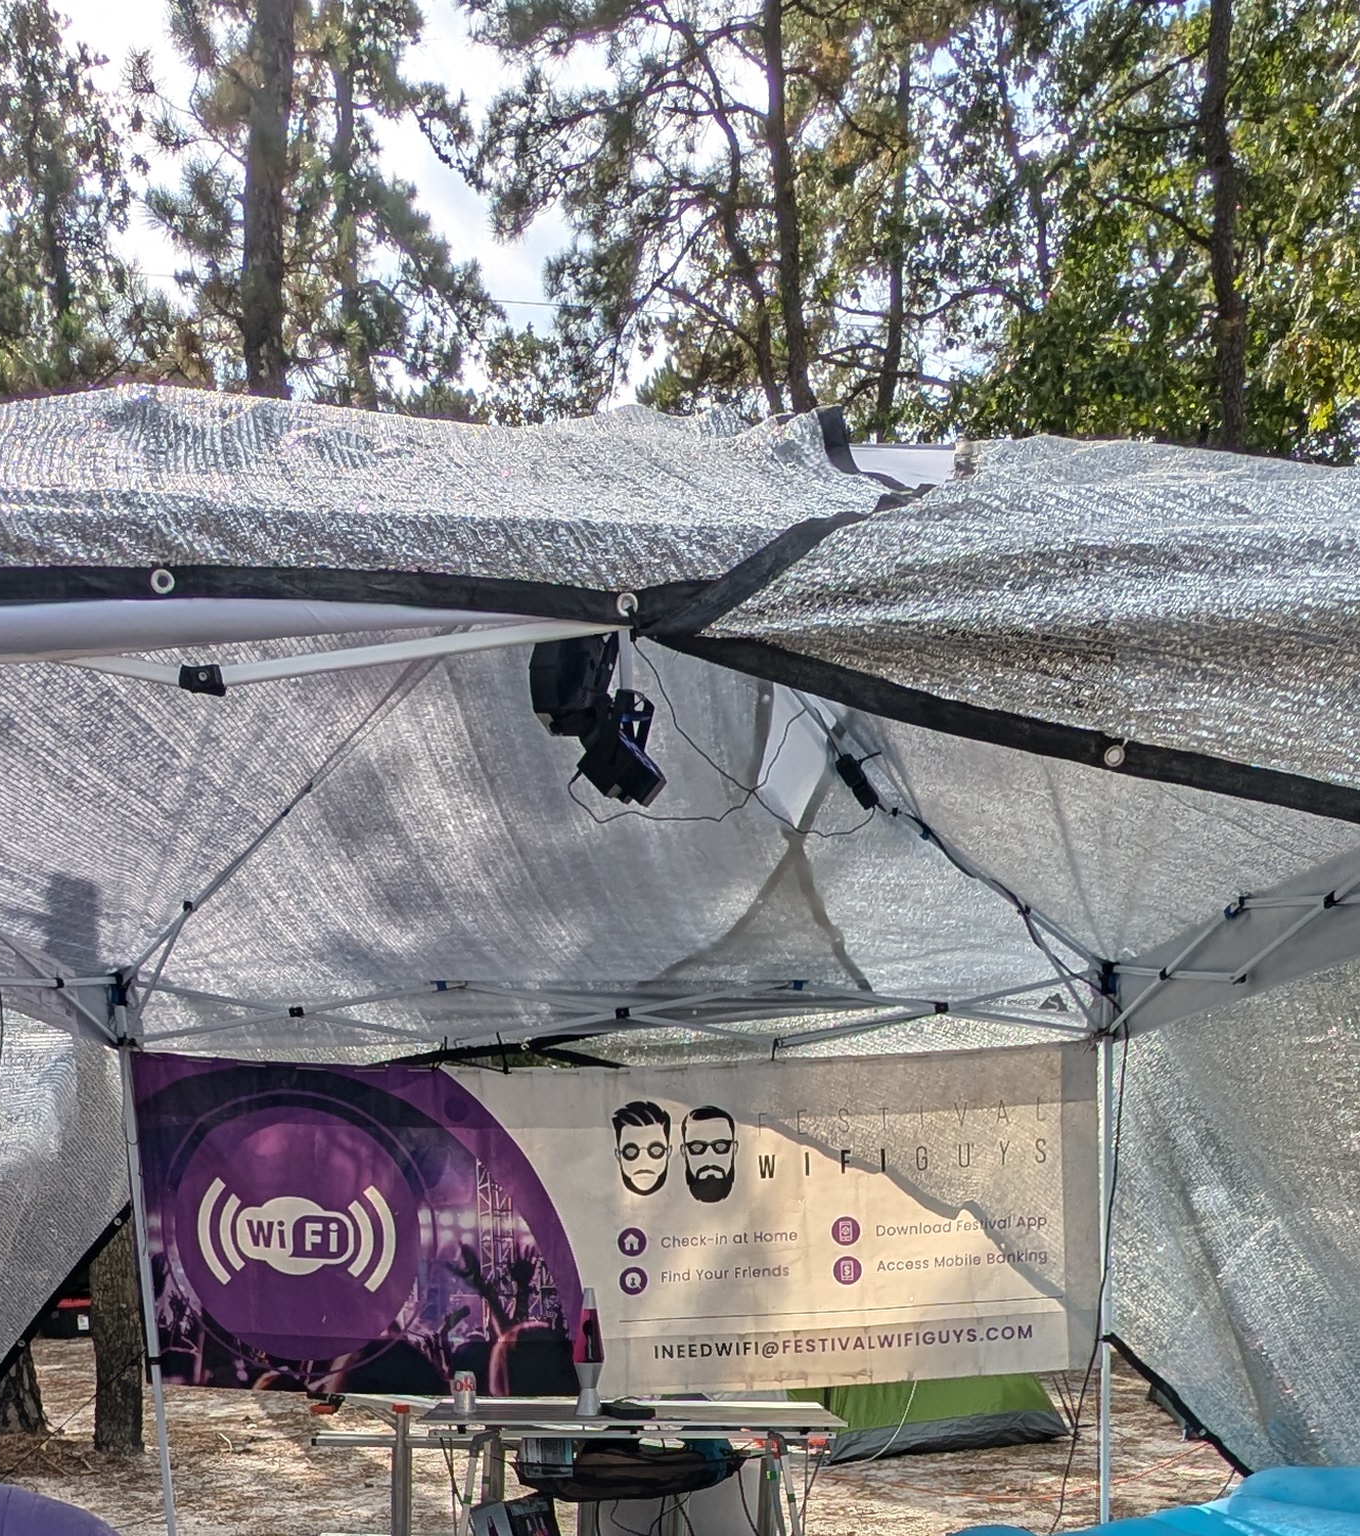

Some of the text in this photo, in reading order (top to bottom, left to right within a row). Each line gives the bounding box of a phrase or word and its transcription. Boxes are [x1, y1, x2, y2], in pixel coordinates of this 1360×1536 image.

[758, 1097, 1046, 1137] FESTIVAL
[875, 1215, 1047, 1237] Download Festival App
[661, 1229, 798, 1249] Check-in at Home
[876, 1249, 1047, 1272] Access Mobile Banking
[661, 1264, 790, 1283] Find Your Friends
[653, 1323, 1034, 1360] INEEDWIFI@FESTIVALWIFIGUYS.COM
